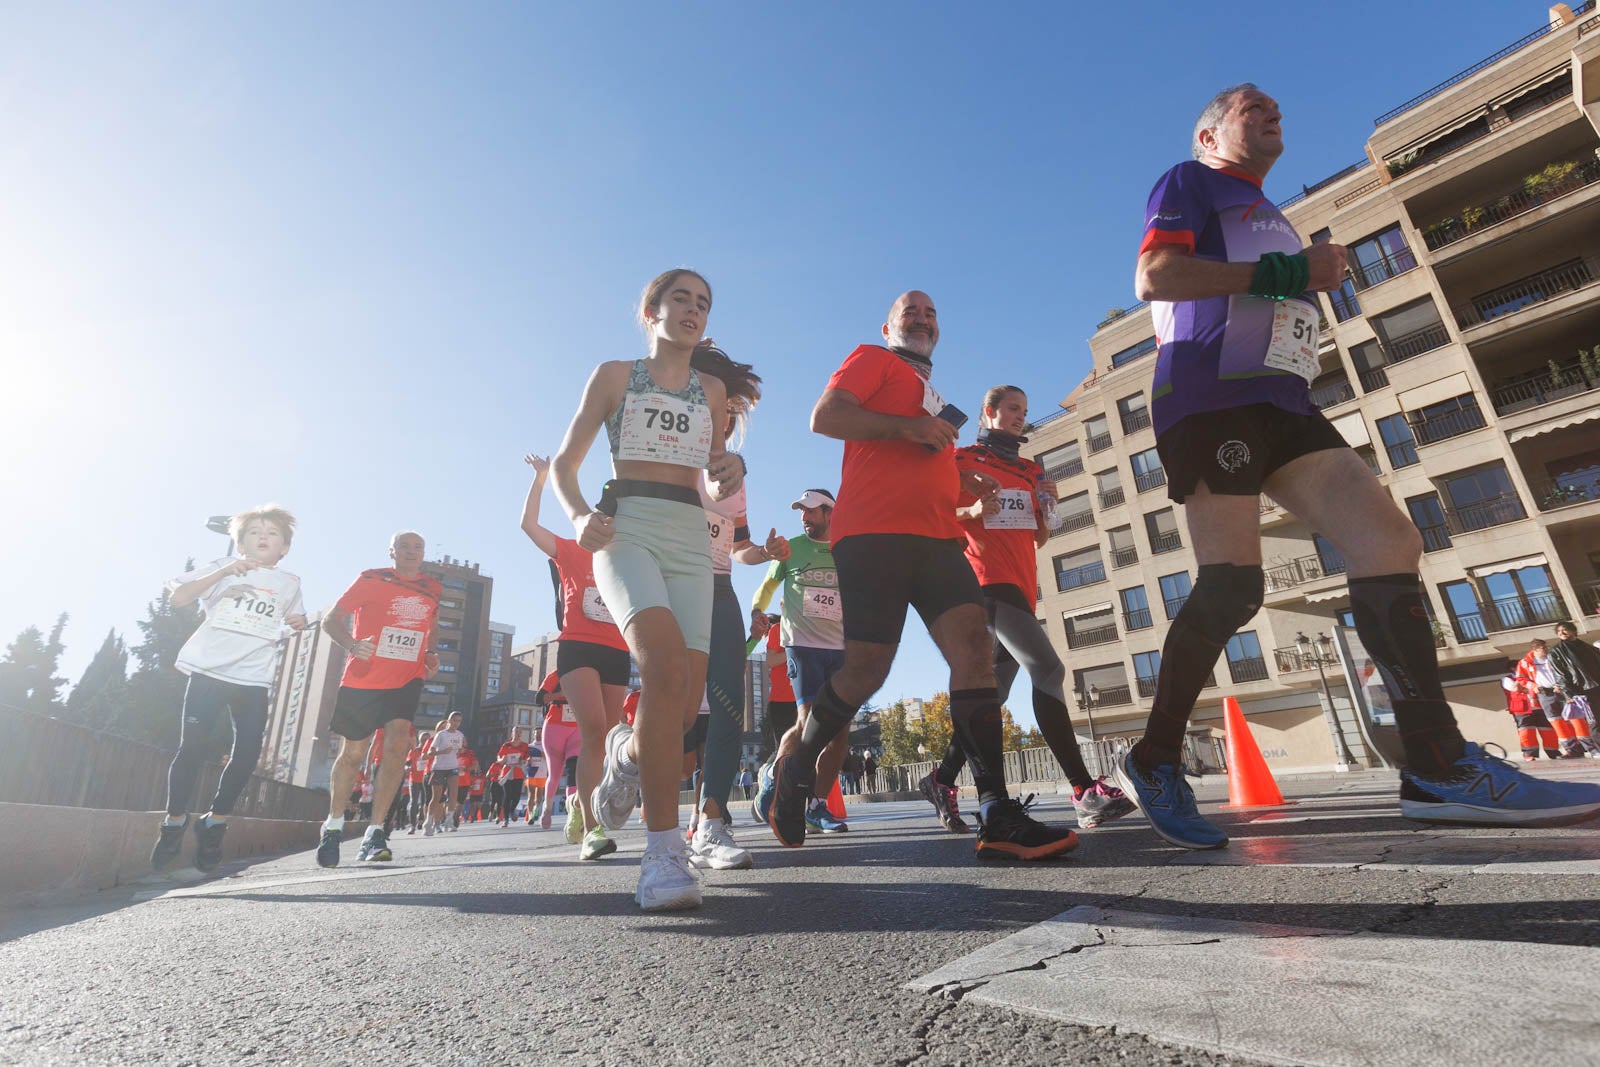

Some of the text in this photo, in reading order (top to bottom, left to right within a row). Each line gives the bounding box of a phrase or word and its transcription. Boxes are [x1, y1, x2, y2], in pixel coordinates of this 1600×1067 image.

[644, 408, 690, 434] 798
[658, 434, 680, 443] ELENA
[1000, 497, 1025, 511] 726
[233, 596, 275, 618] 1102
[813, 594, 835, 606] 426
[388, 633, 416, 647] 1120
